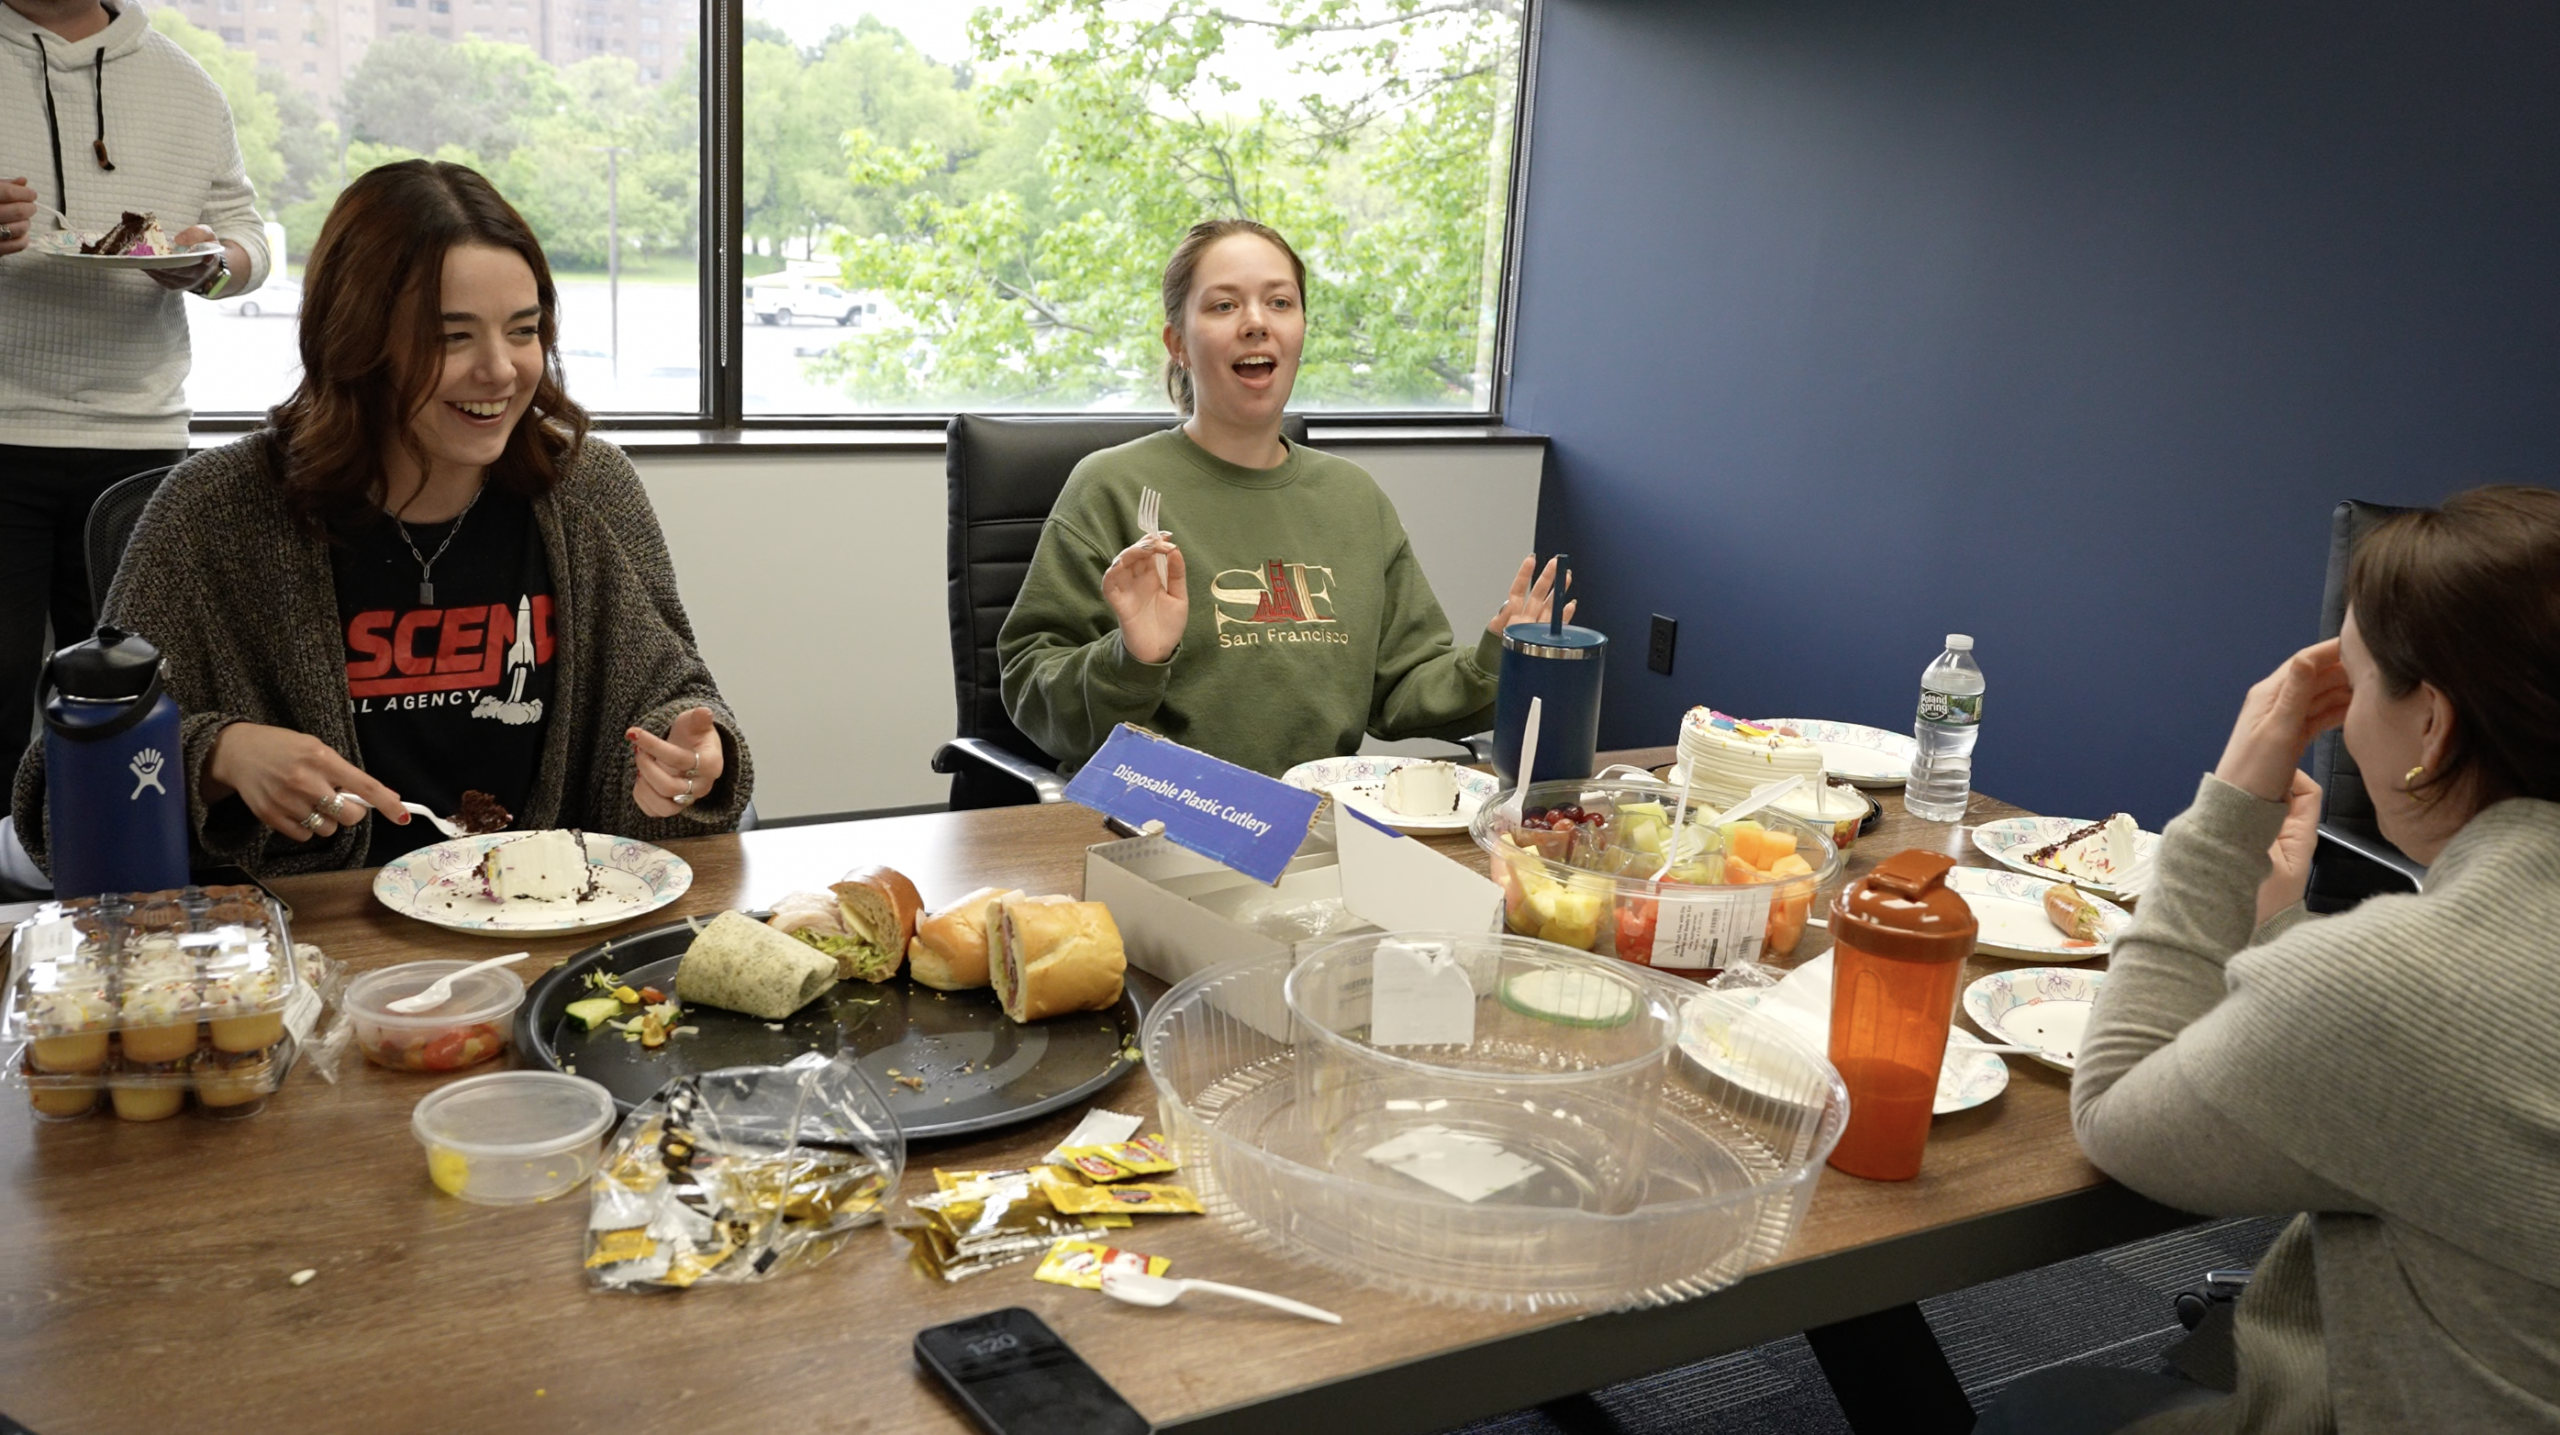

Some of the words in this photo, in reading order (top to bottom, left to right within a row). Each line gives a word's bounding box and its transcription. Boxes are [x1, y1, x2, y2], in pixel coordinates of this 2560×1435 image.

[346, 594, 557, 681] SCEND
[1219, 631, 1260, 648] San
[1267, 627, 1350, 645] Francisco
[384, 689, 483, 711] AGENCY
[1920, 693, 1948, 704] Poland
[1920, 703, 1948, 714] Spring
[1112, 763, 1181, 799] Disposable
[1176, 788, 1225, 816] Plastic
[1220, 805, 1273, 837] Cutlery
